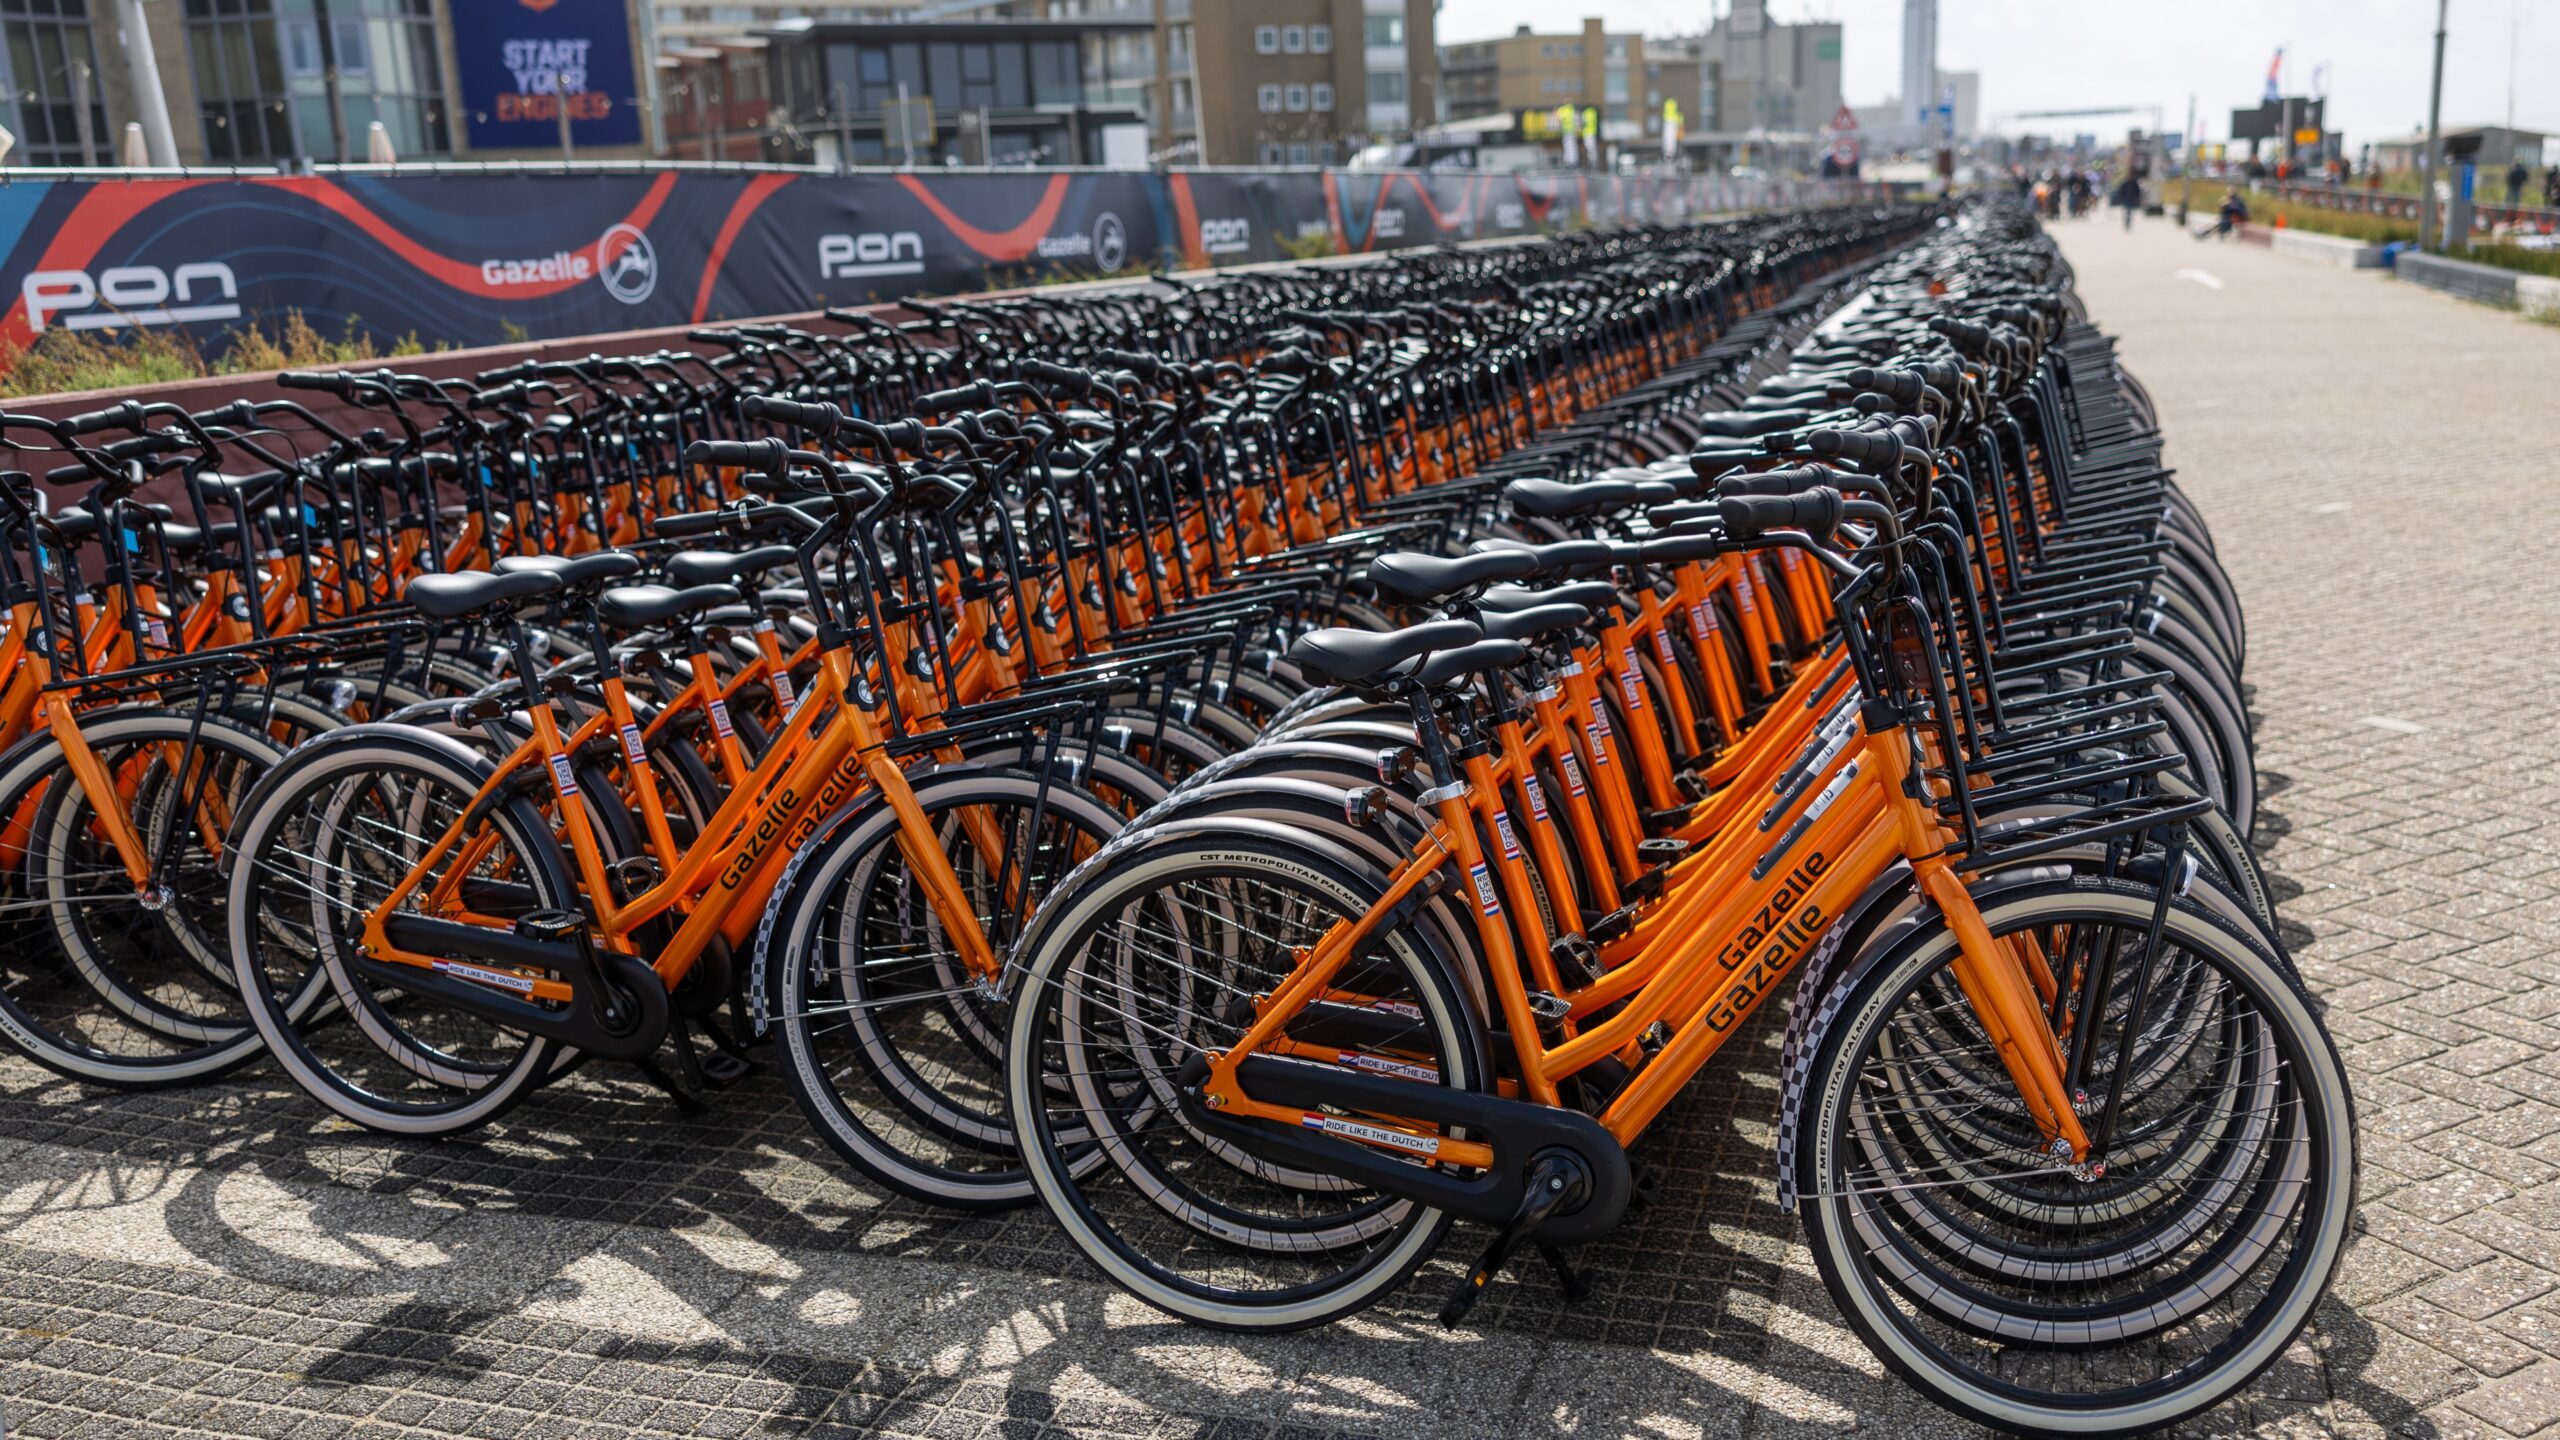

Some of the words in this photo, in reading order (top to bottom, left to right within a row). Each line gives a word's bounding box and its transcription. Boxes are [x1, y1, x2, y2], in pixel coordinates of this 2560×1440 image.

[502, 38, 590, 69] START
[1201, 218, 1249, 252] pon
[481, 251, 590, 286] Gazelle
[818, 231, 924, 279] pon
[22, 261, 239, 333] pon
[785, 754, 863, 853] Gazelle
[720, 787, 800, 891] Gazelle
[2225, 833, 2240, 851] CST
[1521, 853, 1534, 872] CST
[1200, 854, 1221, 862] CST
[1224, 854, 1320, 884] METROPOLITAN
[1321, 879, 1372, 914] PALMBA
[1717, 851, 1832, 971] Gazelle
[449, 965, 465, 974] RIDE
[484, 973, 497, 982] THE
[498, 976, 523, 987] DUTCH
[1705, 905, 1829, 1033] Gazelle
[1395, 1005, 1414, 1016] RIDE
[1360, 1058, 1379, 1069] RIDE
[1382, 1063, 1401, 1073] LIKE
[1403, 1067, 1420, 1077] THE
[1421, 1071, 1439, 1082] DUT
[1820, 1061, 1846, 1168] METROPOLITAN
[1843, 996, 1881, 1060] PALMBAY
[1326, 1120, 1346, 1131] RIDE
[1349, 1125, 1368, 1136] LIKE
[1371, 1130, 1389, 1141] THE
[1392, 1135, 1424, 1148] DUTCH
